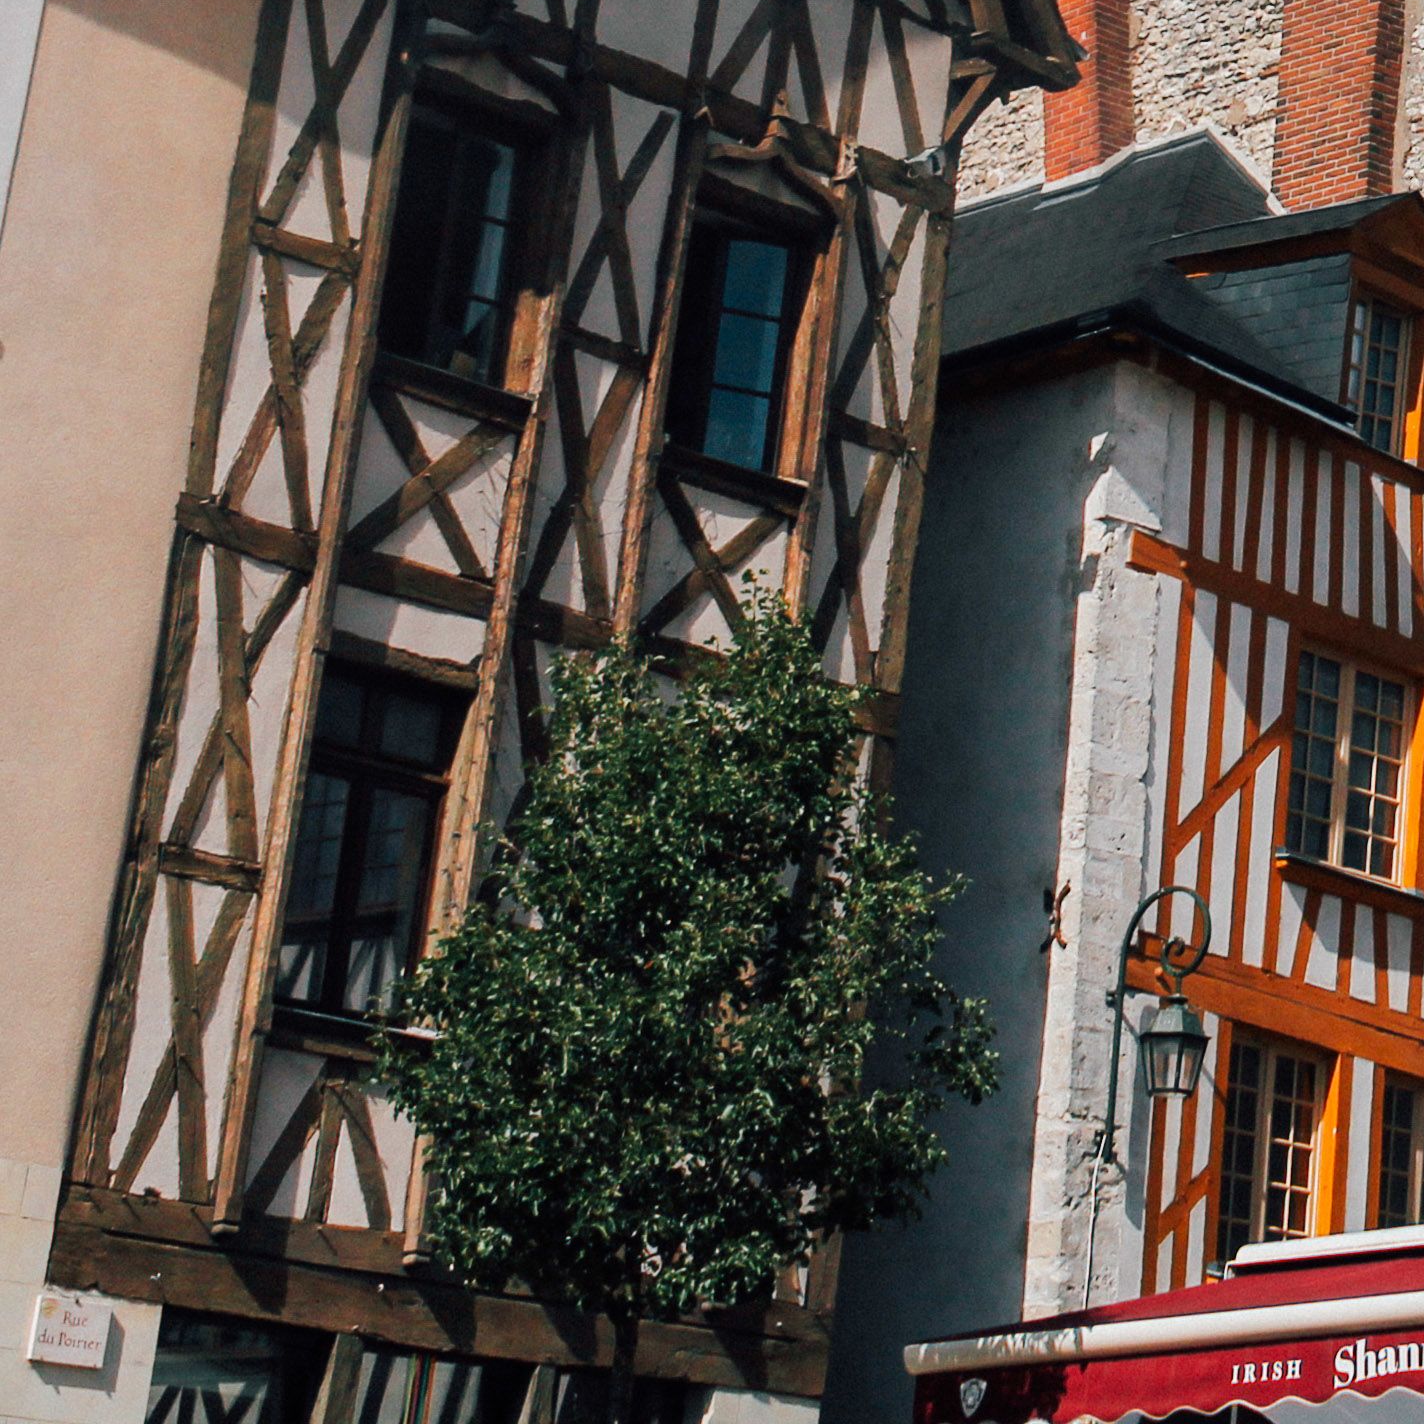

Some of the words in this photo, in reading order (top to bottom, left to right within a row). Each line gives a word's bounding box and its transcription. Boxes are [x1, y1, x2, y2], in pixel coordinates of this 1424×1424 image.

[62, 1311, 89, 1328] Rue
[38, 1328, 55, 1344] du
[58, 1331, 102, 1350] Poirier
[1230, 1359, 1302, 1385] IRISH
